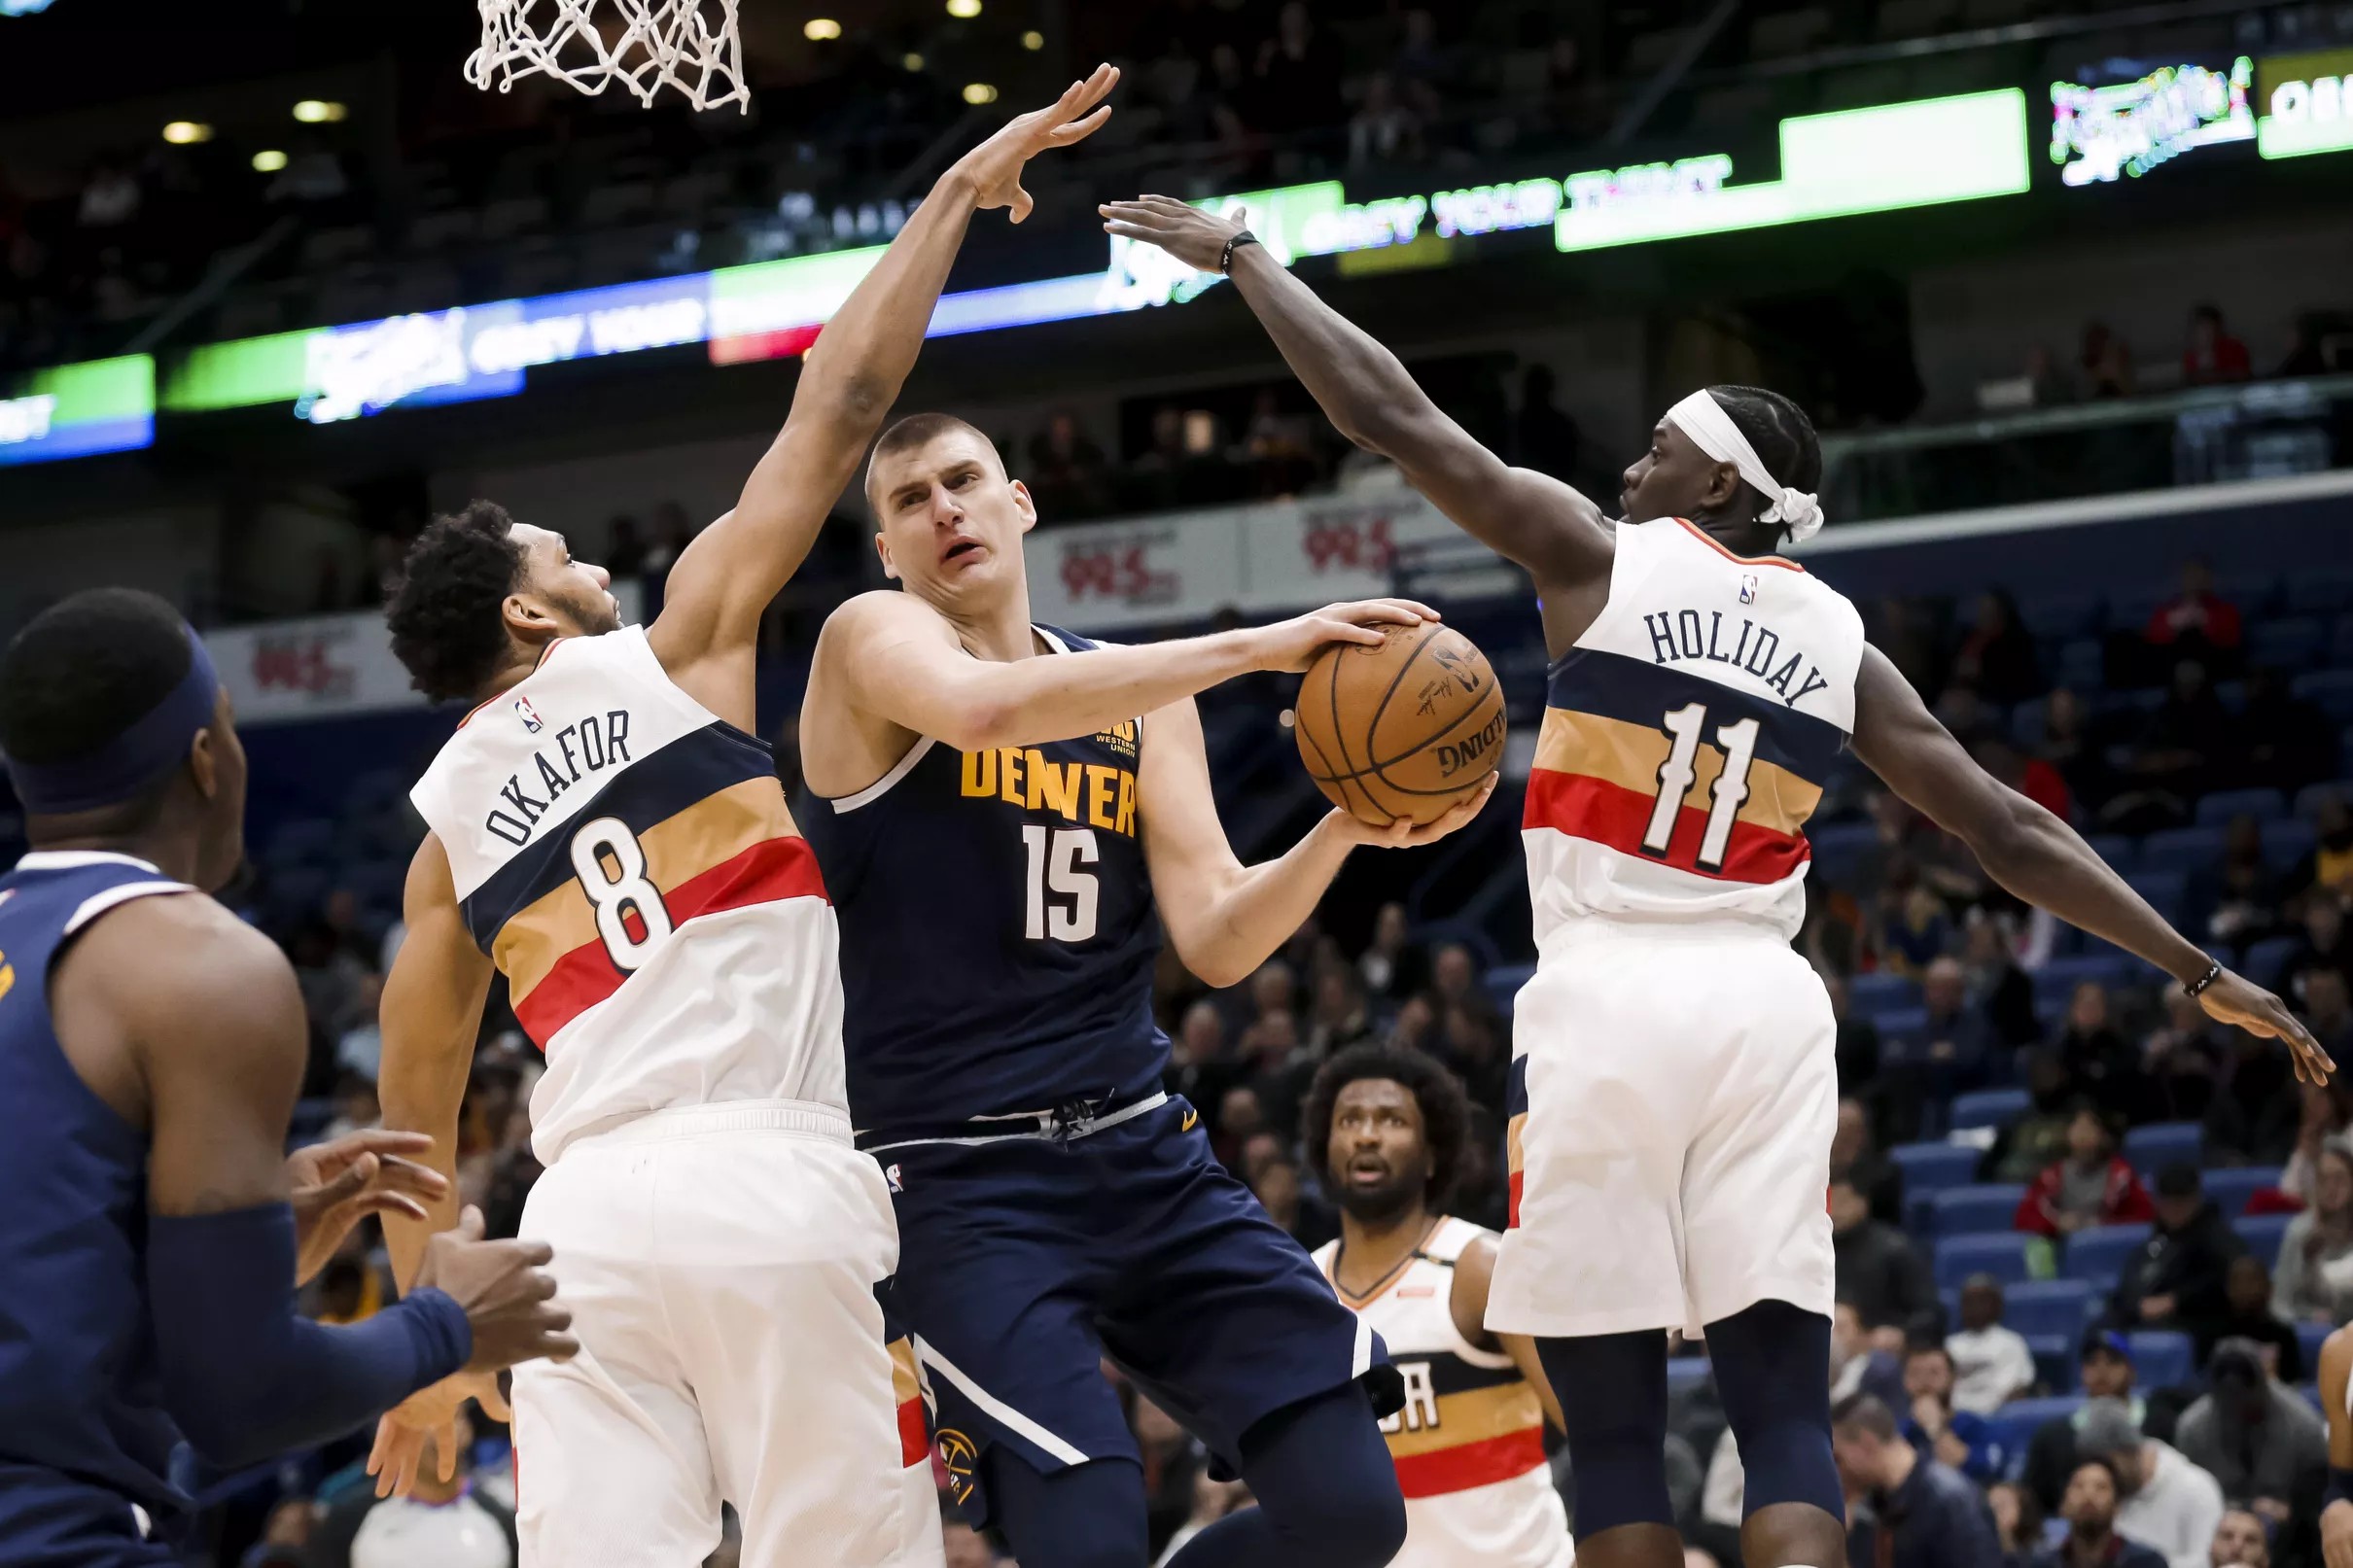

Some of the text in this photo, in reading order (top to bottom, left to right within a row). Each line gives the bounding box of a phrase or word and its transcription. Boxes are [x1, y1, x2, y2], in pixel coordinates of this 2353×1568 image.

[1643, 610, 1828, 708] HOLIDAY
[486, 710, 630, 847] OKAFOR
[962, 747, 1136, 838] DENVER
[1096, 735, 1136, 751] WESTERN
[1110, 744, 1136, 758] UNION
[1639, 702, 1760, 871] 11
[571, 816, 674, 971] 8
[1023, 825, 1099, 942] 15
